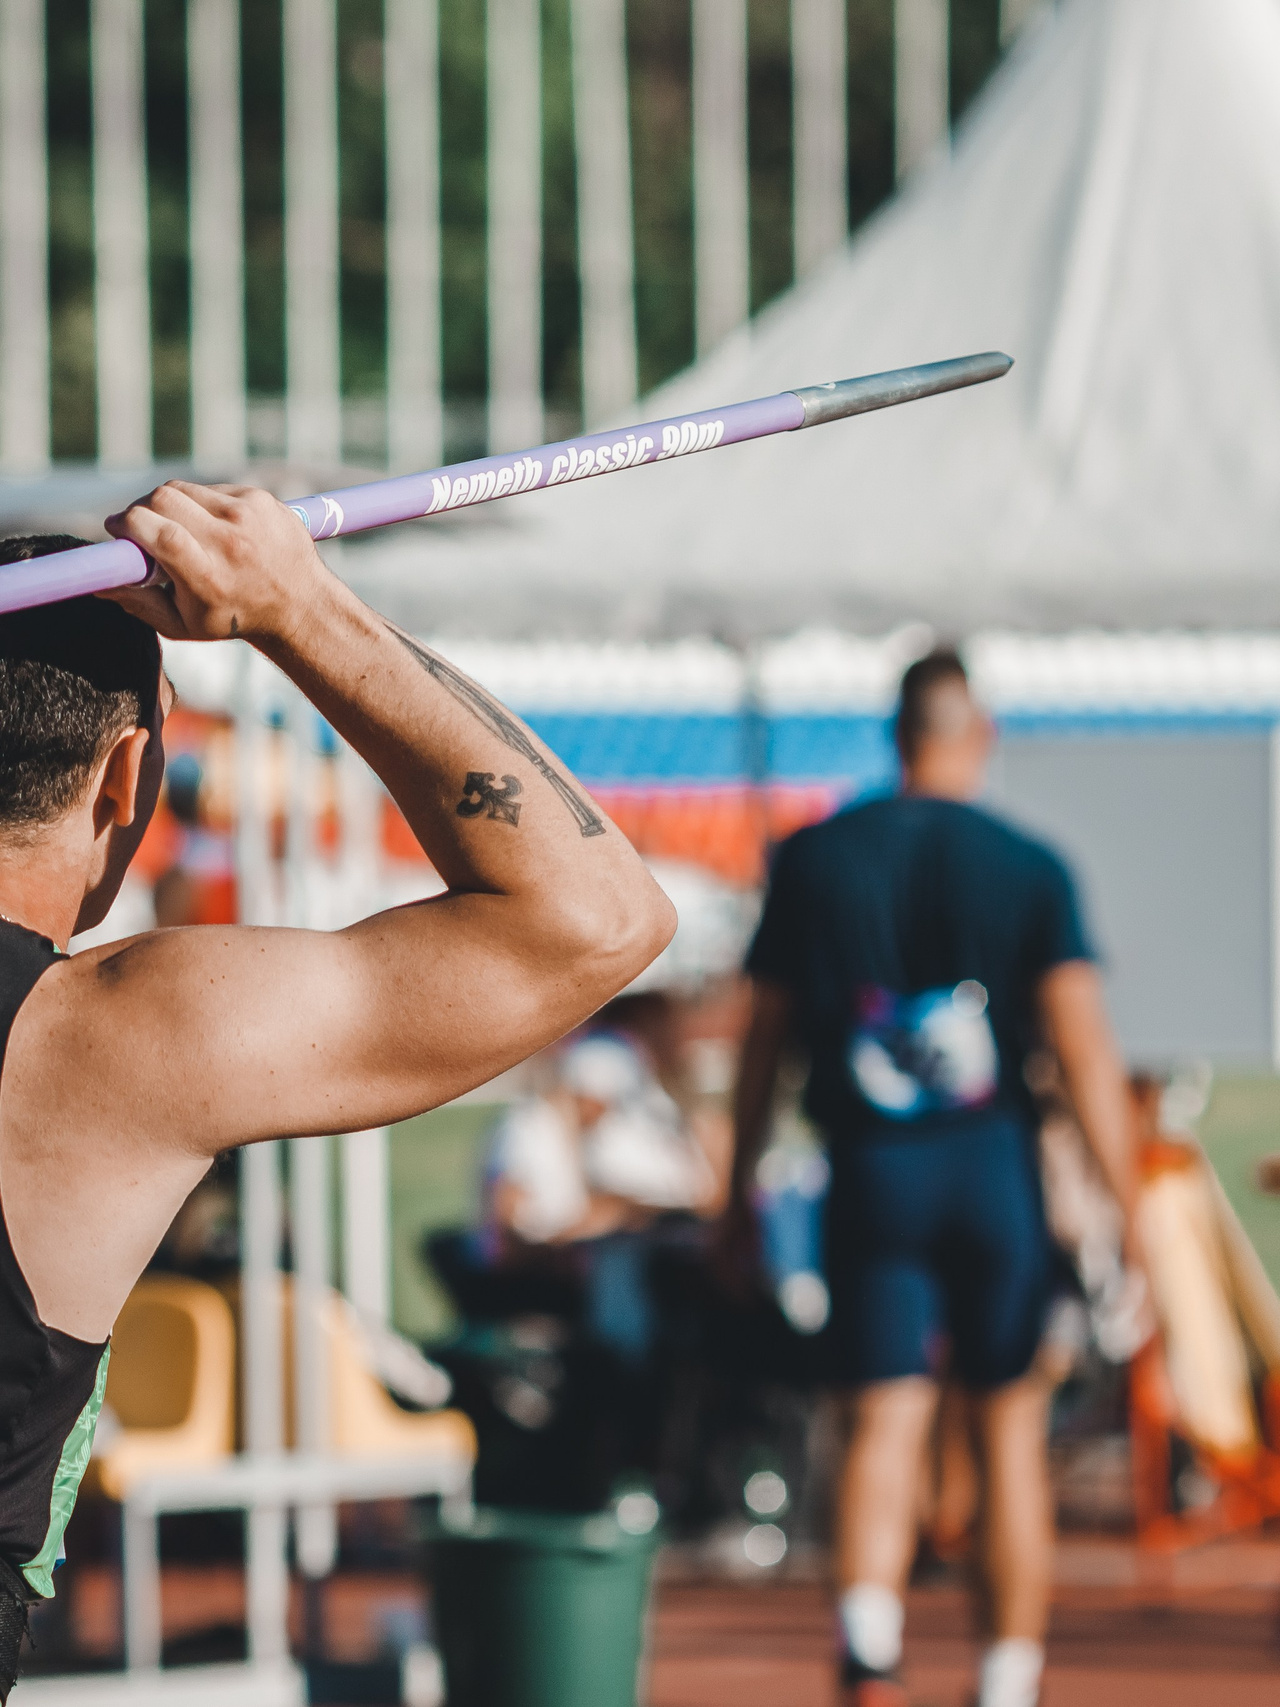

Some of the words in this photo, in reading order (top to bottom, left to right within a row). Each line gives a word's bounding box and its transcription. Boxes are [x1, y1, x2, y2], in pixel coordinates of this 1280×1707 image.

[424, 455, 543, 515] Nemeth
[546, 434, 654, 487] classic
[656, 419, 725, 461] 90m
